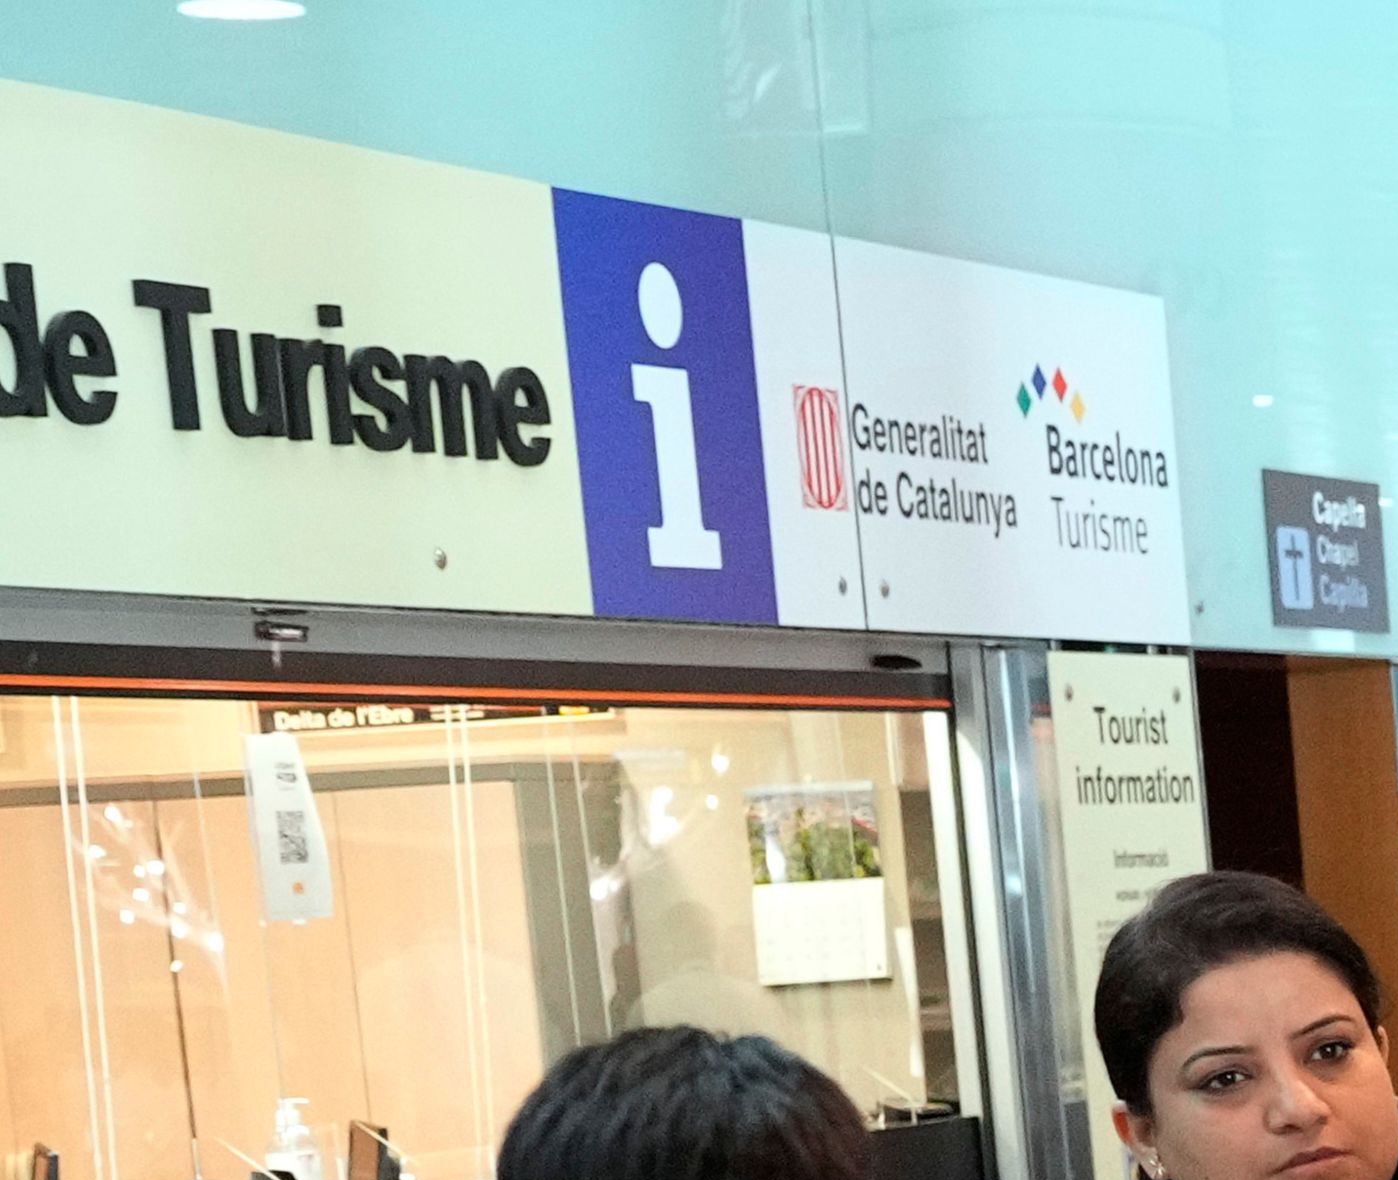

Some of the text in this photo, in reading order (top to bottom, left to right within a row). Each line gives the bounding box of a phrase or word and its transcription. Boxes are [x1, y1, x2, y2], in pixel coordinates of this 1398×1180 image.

[0, 262, 552, 467] de Turisme
[852, 403, 989, 464] Generalitat
[1046, 423, 1169, 488] Barcelona
[858, 468, 1018, 538] de Catalunya
[1051, 496, 1149, 554] Turisme
[1093, 706, 1169, 745] Tourist
[1075, 765, 1195, 805] information
